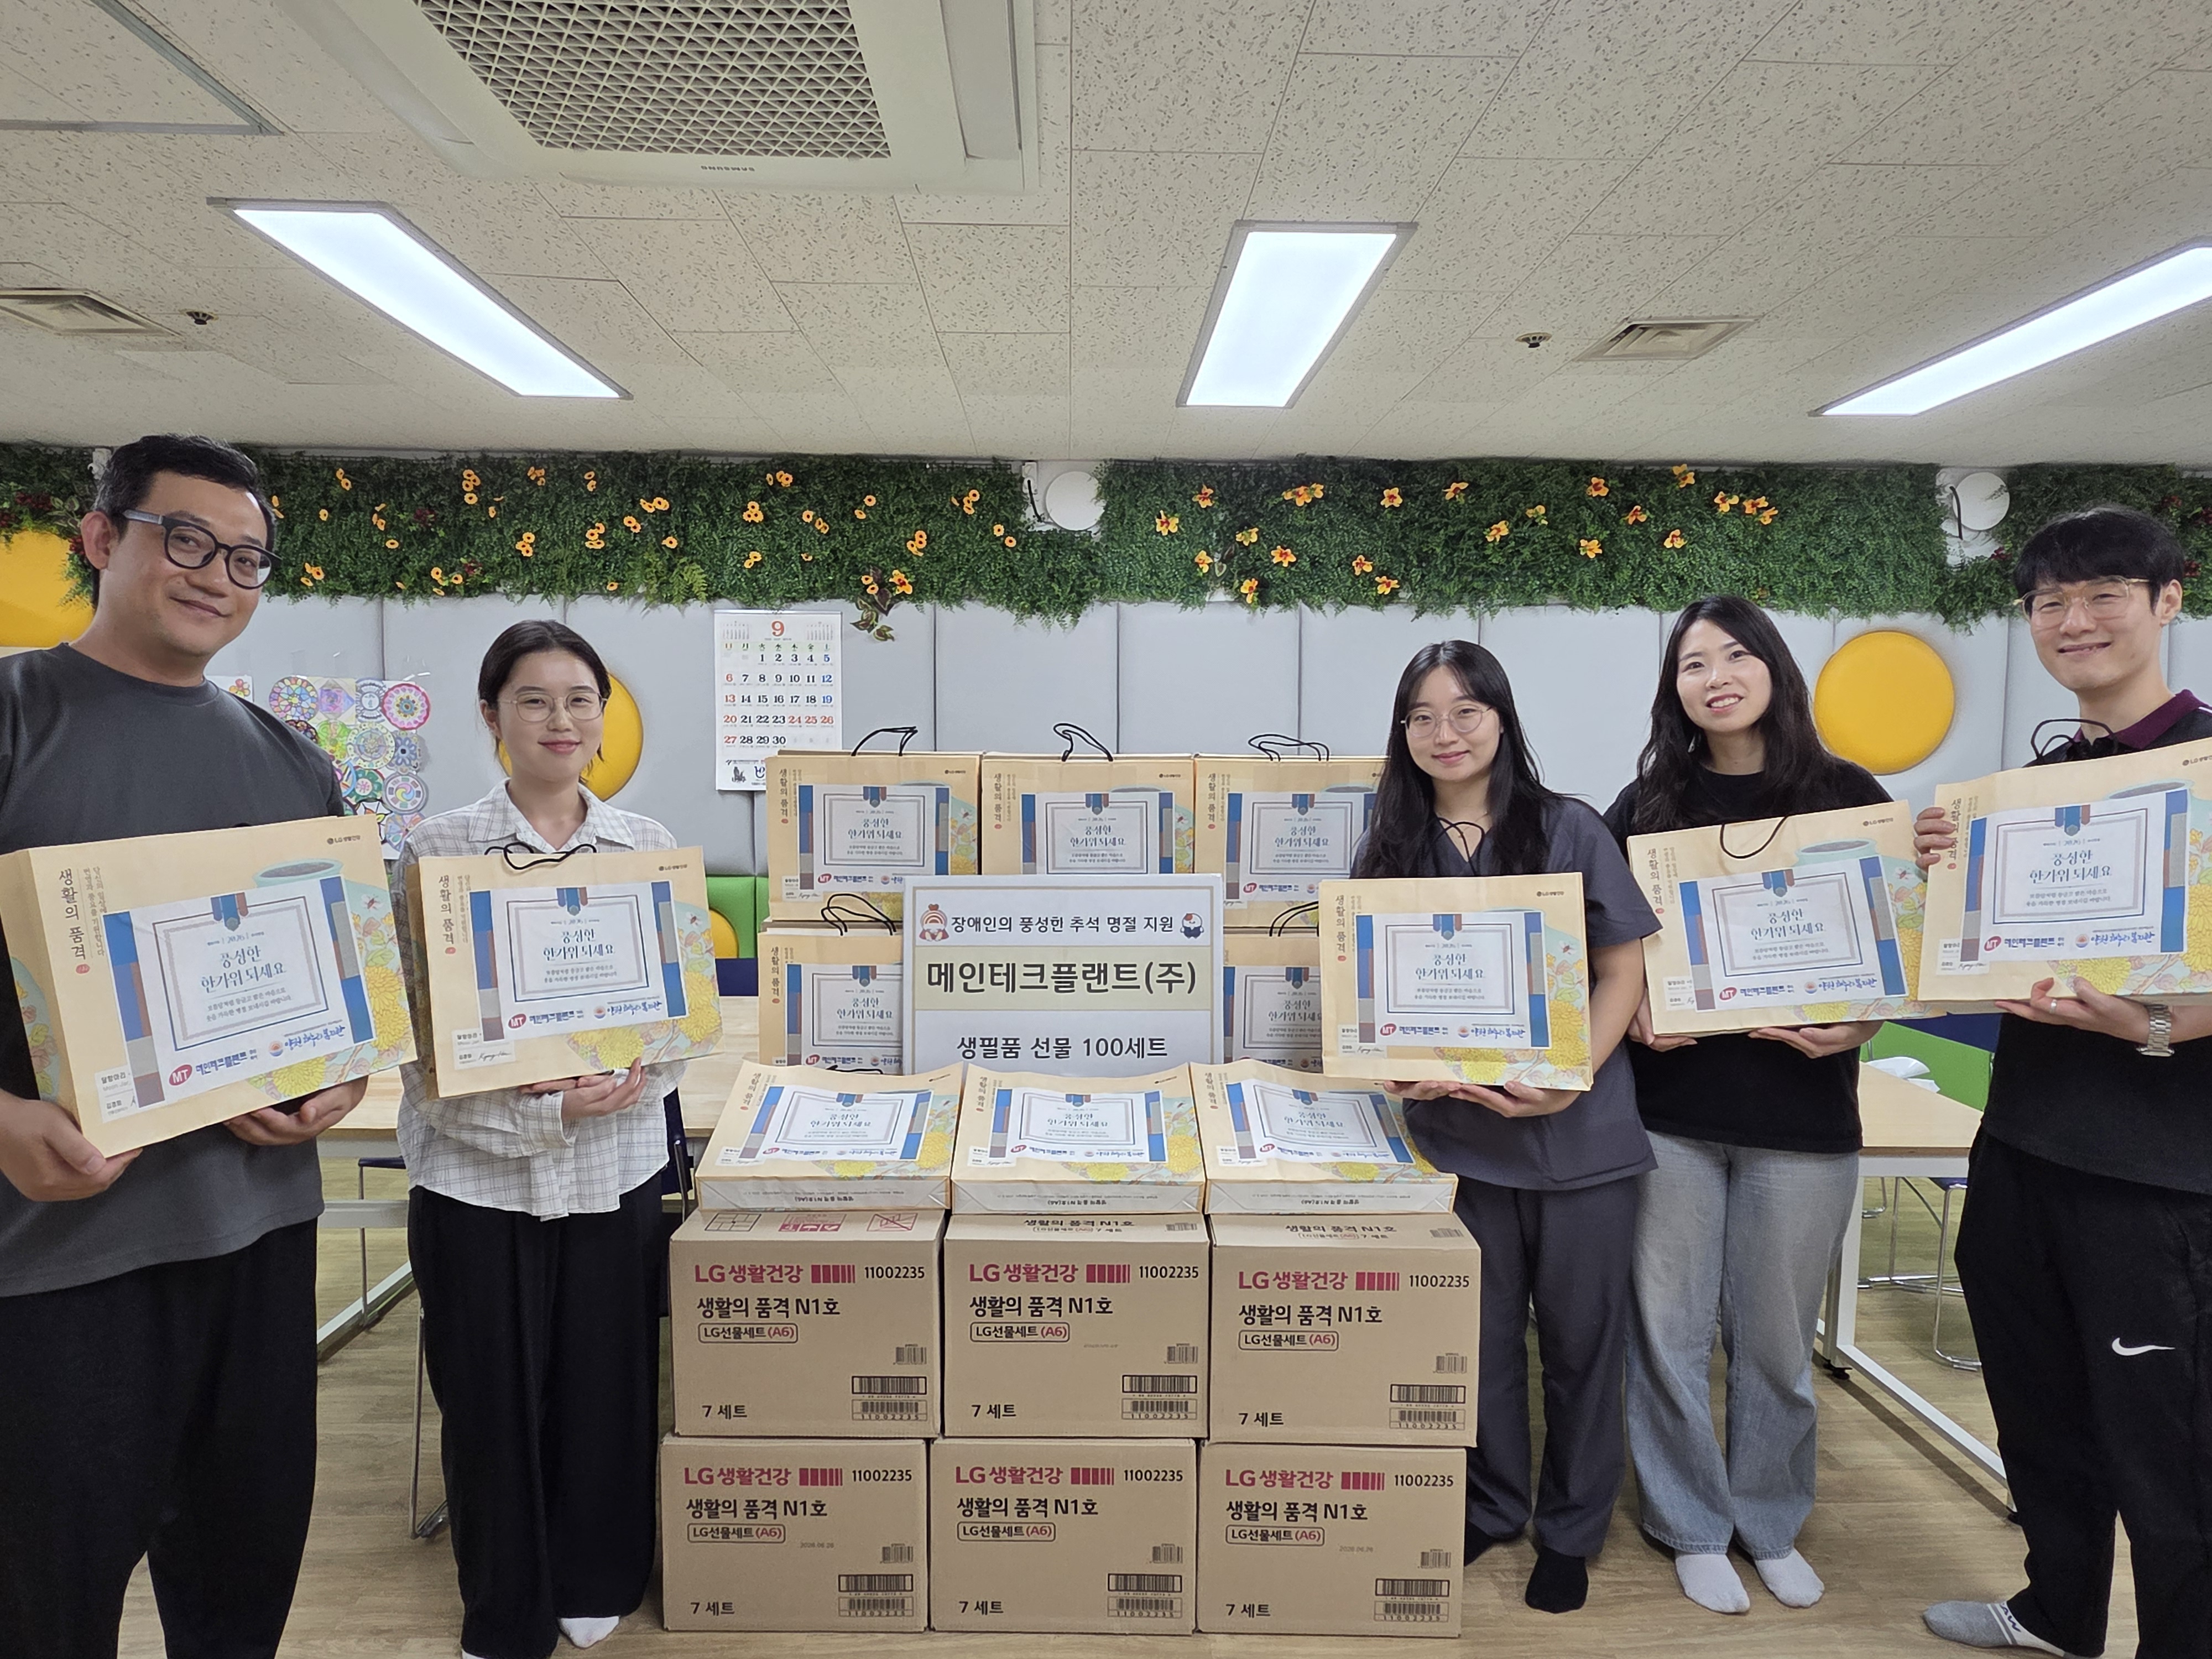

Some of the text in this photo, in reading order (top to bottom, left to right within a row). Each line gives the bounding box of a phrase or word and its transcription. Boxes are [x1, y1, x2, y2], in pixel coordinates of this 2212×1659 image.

[771, 621, 784, 637] 9
[775, 674, 782, 682] 9
[772, 716, 785, 724] 23
[821, 716, 833, 724] 26
[773, 736, 786, 744] 30
[59, 868, 86, 960] 생활의 품격
[439, 875, 454, 945] 생활의 품격
[952, 917, 1172, 932] 장애인의 풍성한 추석 명절 지원
[221, 945, 262, 968] 풍성한
[201, 962, 286, 993] 한가위 되세요
[928, 962, 1195, 994] 메인테크플랜트(주)
[510, 1017, 524, 1028] MT
[1381, 1025, 1395, 1035] MT
[957, 1037, 1167, 1059] 생필품 선물 100세트
[173, 1070, 188, 1083] MT
[865, 1266, 924, 1278] 11002235
[1140, 1266, 1198, 1278] 11002235
[1410, 1275, 1469, 1287] 11002235
[697, 1297, 840, 1318] 생활의 품격 N1호
[970, 1296, 1113, 1317] 생활의 품격 N1호
[1239, 1305, 1382, 1326] 생활의 품격 N1호
[702, 1405, 747, 1420] 7 세트
[972, 1404, 1016, 1419] 7 세트
[1239, 1412, 1284, 1427] 7 세트
[853, 1470, 911, 1481] 11002235
[1124, 1470, 1182, 1481] 11002235
[1395, 1475, 1453, 1486] 11002235
[686, 1499, 827, 1520] 생활의 품격 N1호
[957, 1498, 1098, 1518] 생활의 품격 N1호
[1227, 1501, 1368, 1522] 생활의 품격 N1호
[691, 1602, 734, 1616] 7 세트
[959, 1601, 1003, 1615] 7 세트
[1226, 1604, 1270, 1618] 7 세트
